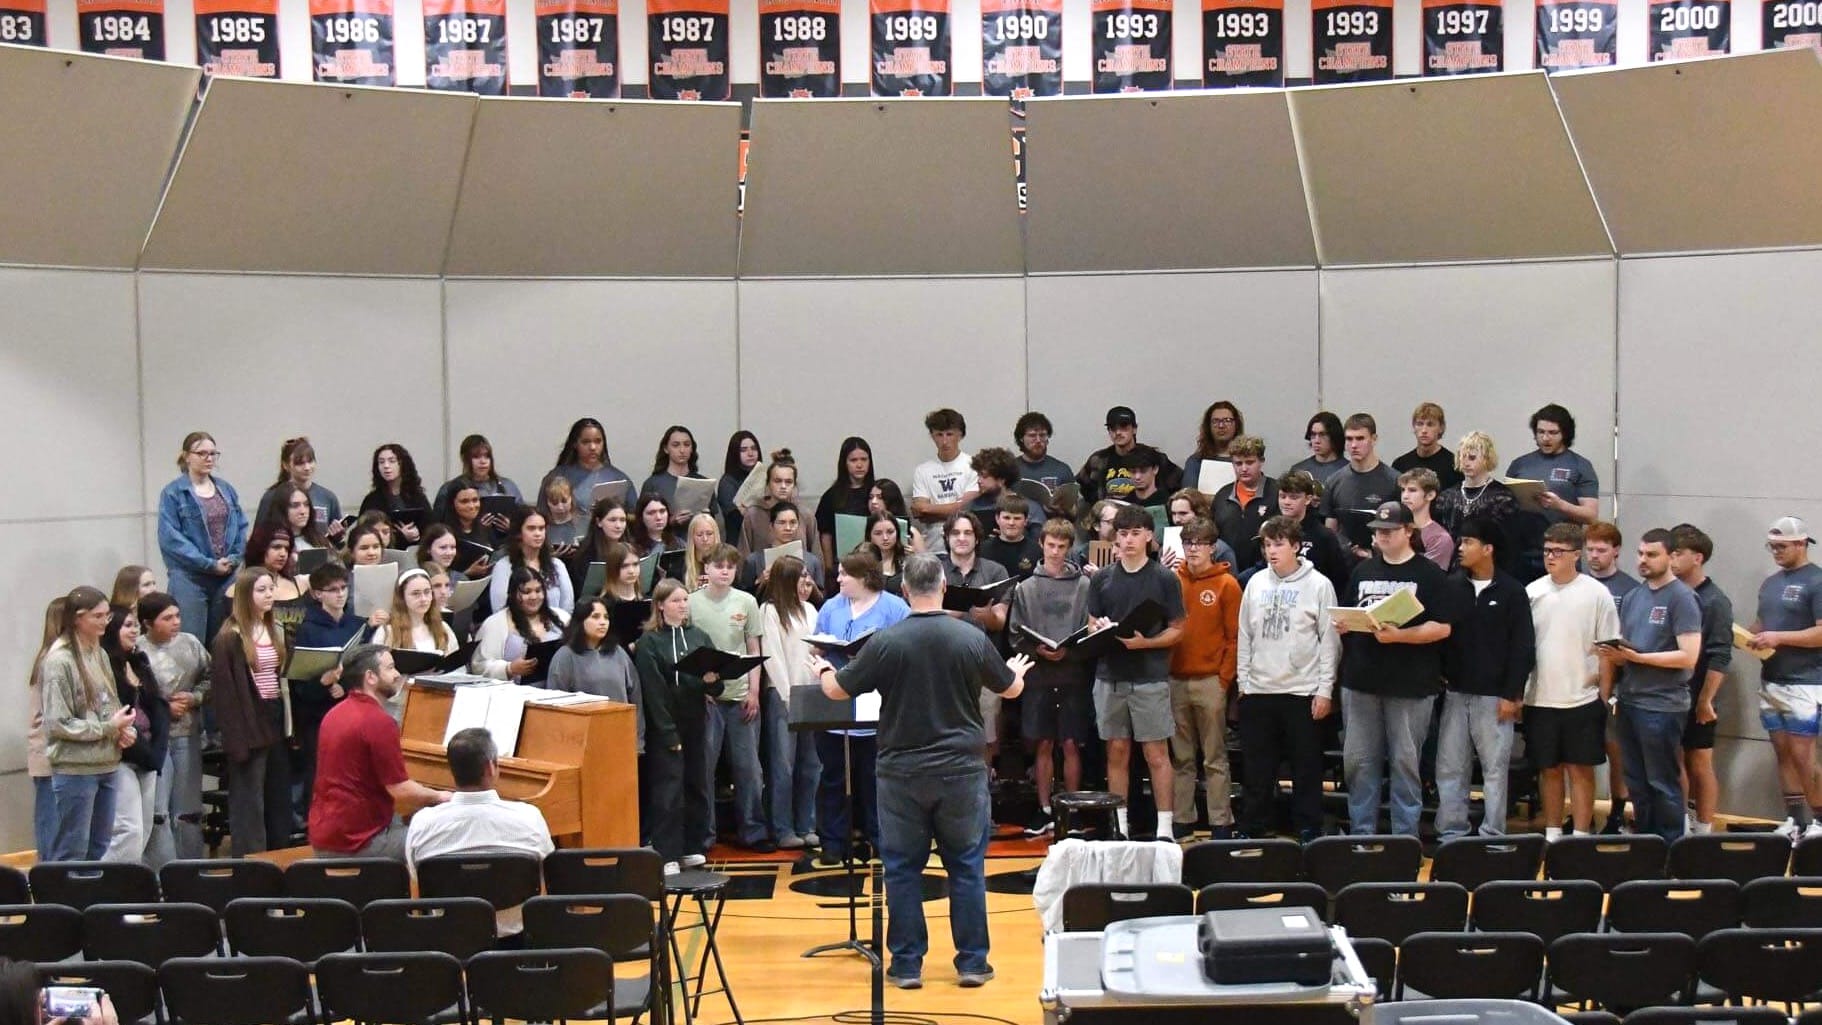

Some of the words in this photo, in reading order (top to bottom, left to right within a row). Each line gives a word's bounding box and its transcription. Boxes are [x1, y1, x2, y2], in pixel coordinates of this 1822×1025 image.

[0, 16, 32, 40] 83
[94, 16, 151, 41] 1984
[211, 18, 265, 42] 1985
[326, 18, 379, 43] 1986
[551, 18, 603, 43] 1987
[662, 17, 714, 41] 1987
[774, 17, 826, 41] 1988
[885, 16, 937, 41] 1989
[995, 15, 1048, 40] 1990
[1106, 14, 1158, 39] 1993
[1217, 13, 1269, 38] 1993
[1327, 11, 1378, 36] 1993
[1437, 10, 1489, 35] 1997
[1550, 8, 1603, 32] 1999
[1660, 5, 1719, 31] 2000
[439, 19, 491, 43] 1987
[939, 478, 957, 492] W
